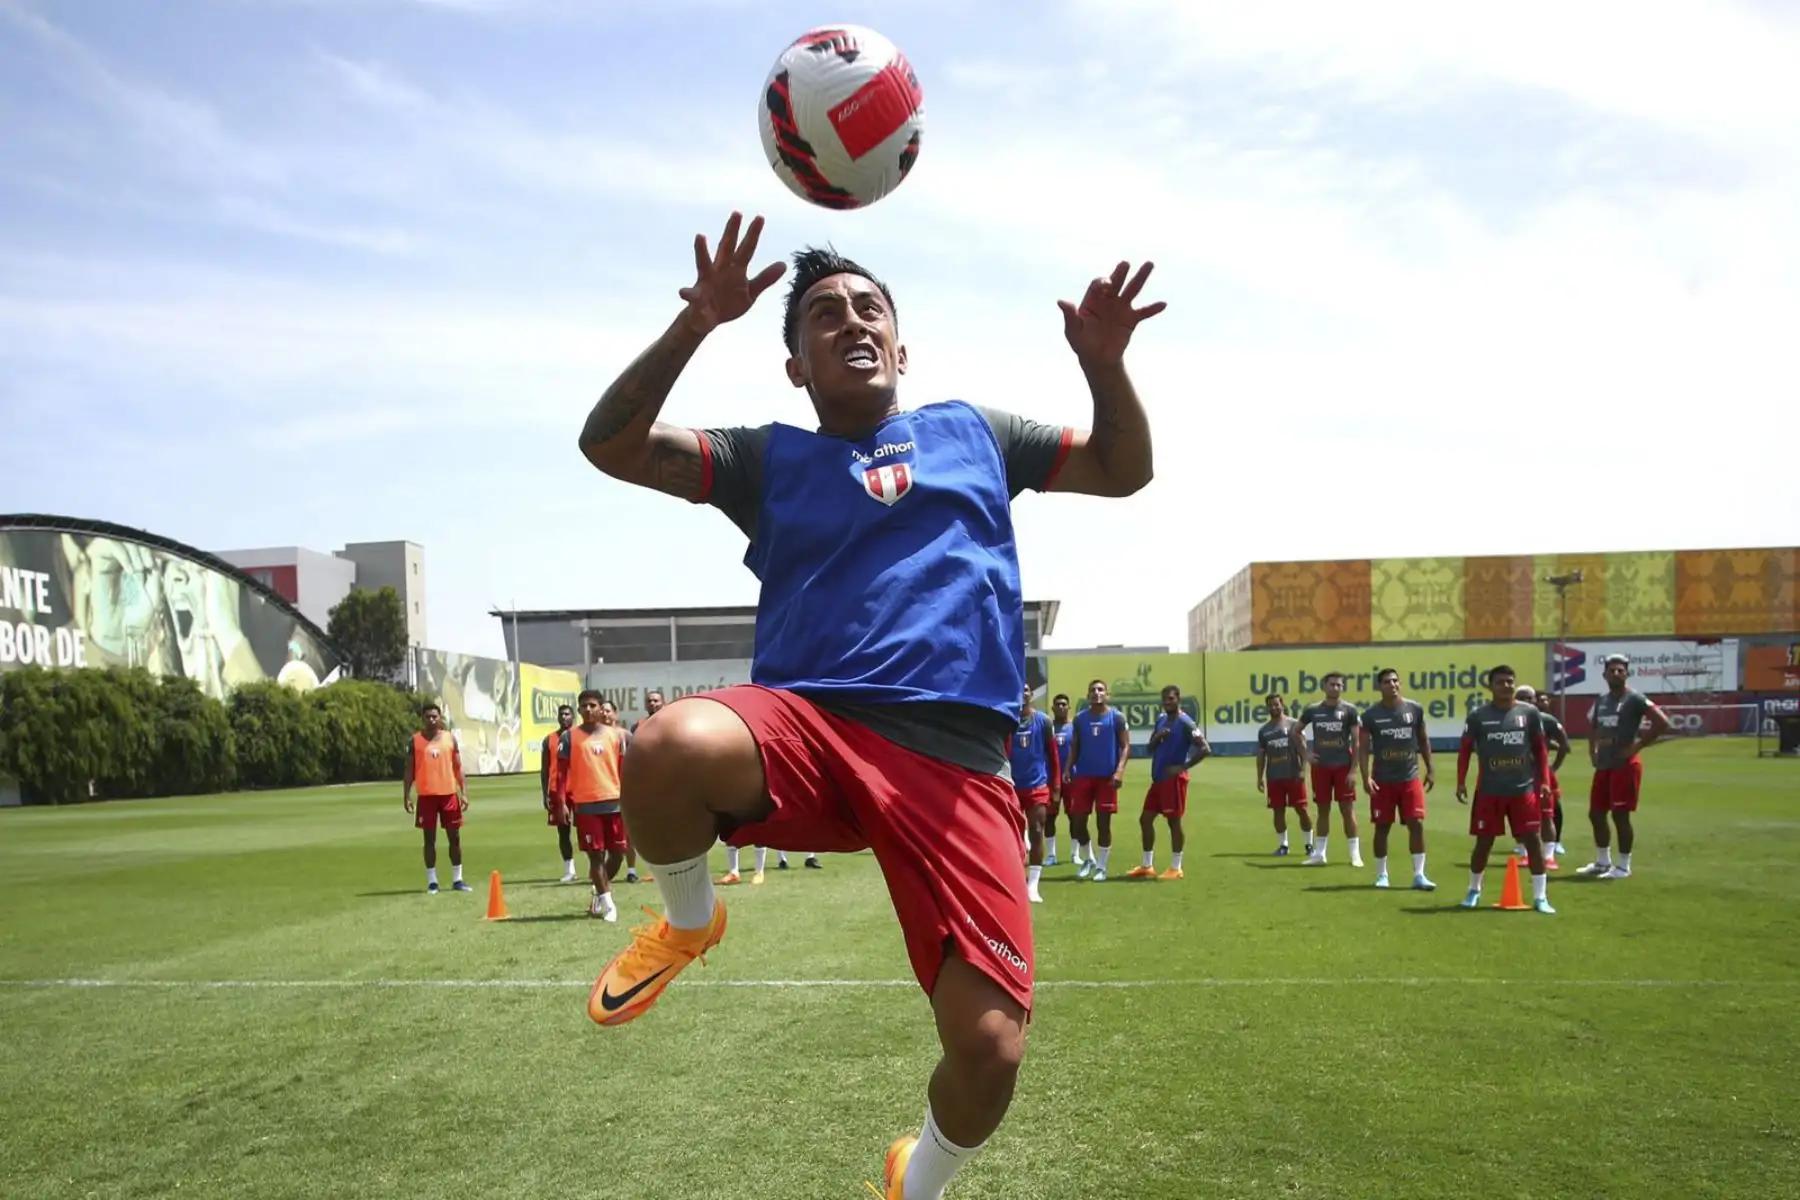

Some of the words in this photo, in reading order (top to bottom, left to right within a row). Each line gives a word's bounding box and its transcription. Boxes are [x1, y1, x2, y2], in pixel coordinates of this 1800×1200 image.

[851, 441, 916, 464] maathon
[0, 565, 53, 614] NTE
[55, 626, 88, 668] DE
[1250, 672, 1289, 695] Un
[1298, 666, 1381, 694] brri
[535, 691, 577, 720] CRIS
[602, 686, 639, 712] IVE
[1214, 698, 1306, 724] aliet
[1428, 693, 1455, 719] el
[966, 914, 1029, 975] athon
